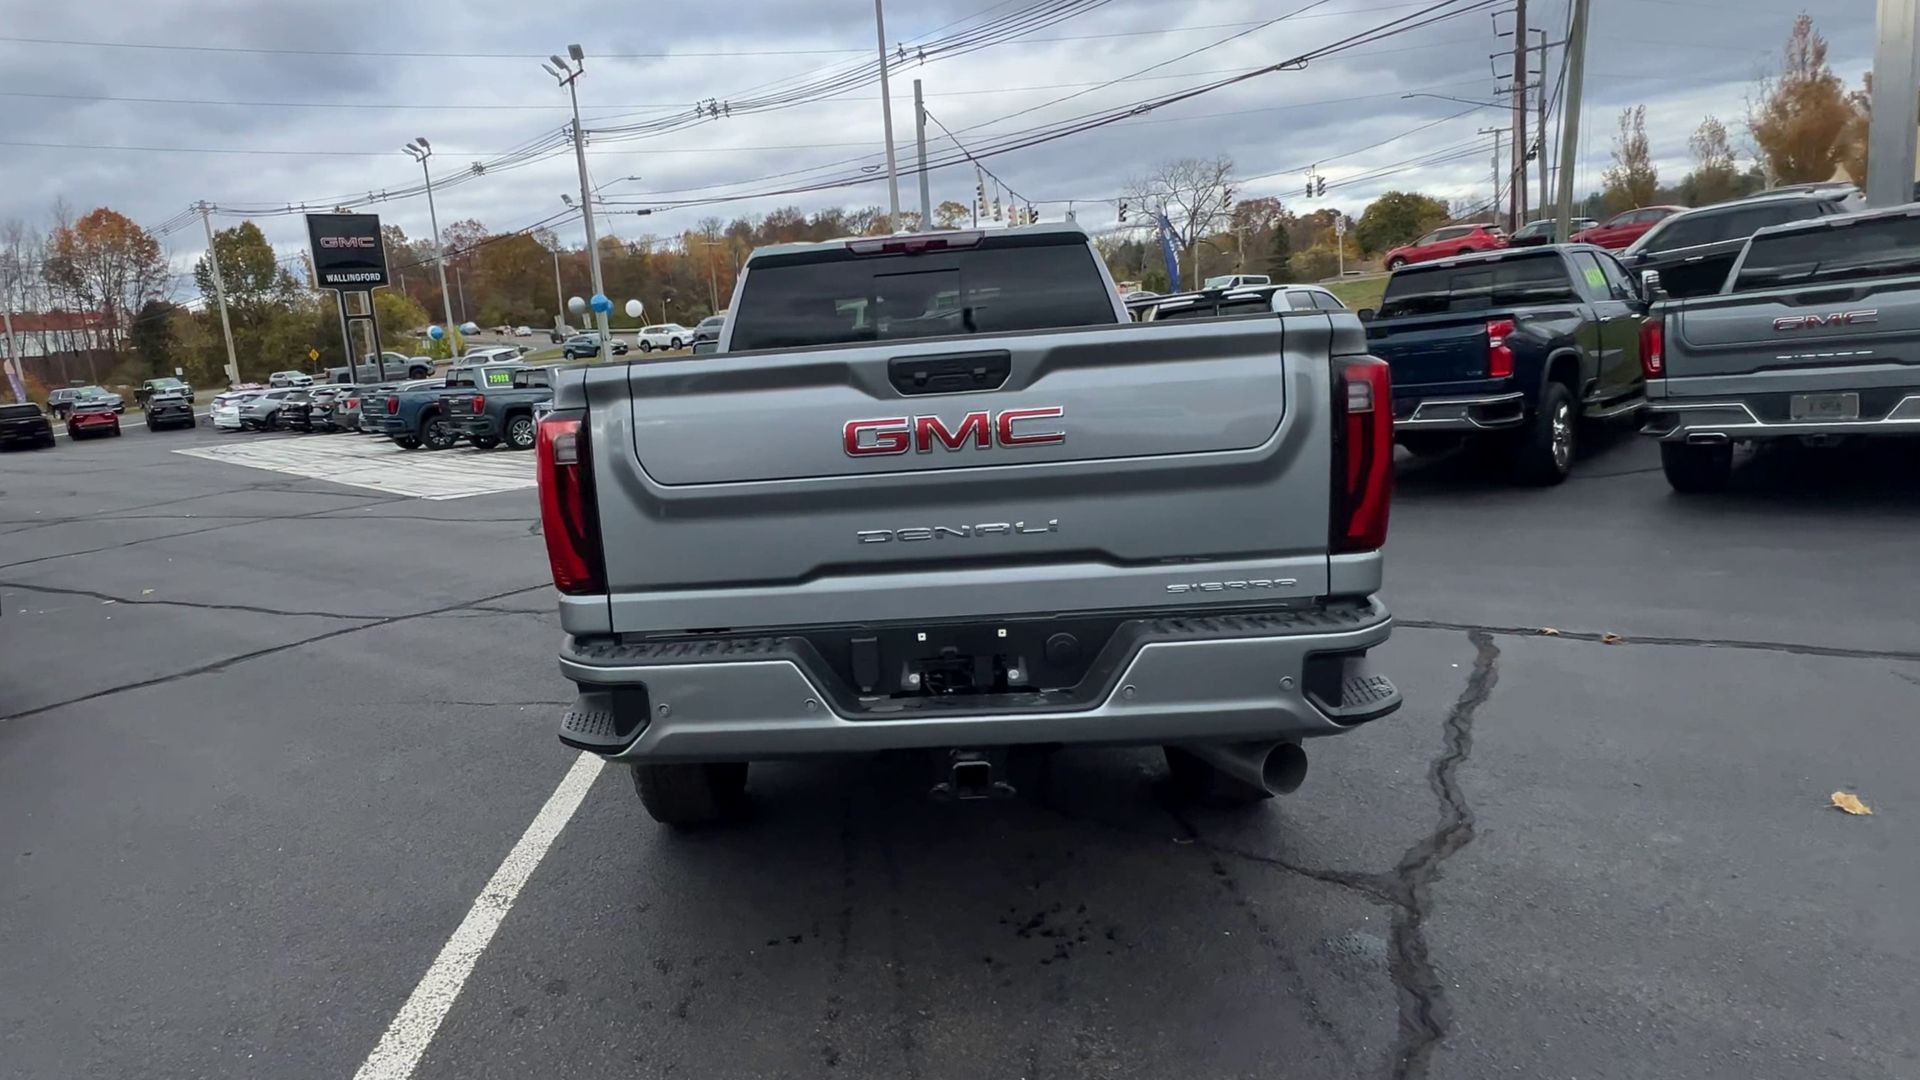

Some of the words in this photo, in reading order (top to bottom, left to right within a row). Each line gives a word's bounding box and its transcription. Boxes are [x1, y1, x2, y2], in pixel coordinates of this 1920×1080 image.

[320, 236, 376, 249] GMC
[325, 272, 381, 283] WALLINGFORD
[1772, 308, 1879, 330] GMC
[842, 406, 1067, 458] GMC
[856, 518, 1058, 545] DENALI
[1166, 578, 1297, 593] SIERRA
